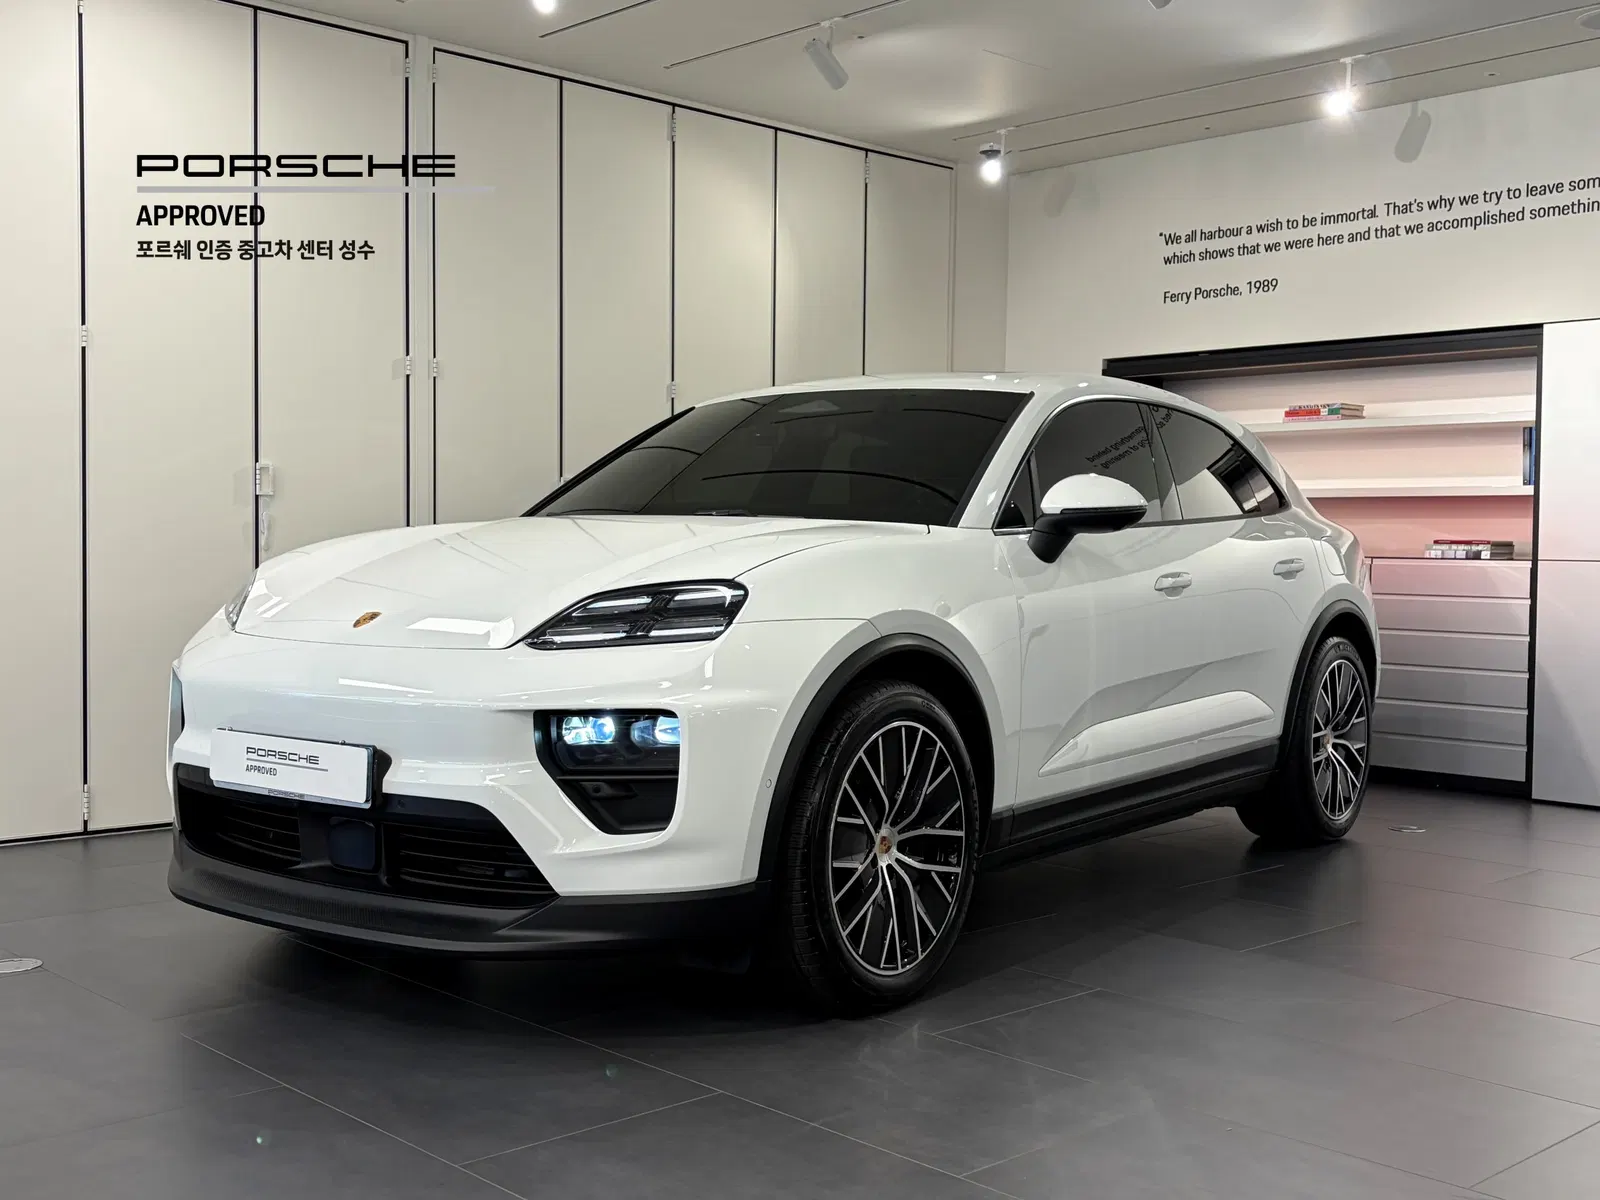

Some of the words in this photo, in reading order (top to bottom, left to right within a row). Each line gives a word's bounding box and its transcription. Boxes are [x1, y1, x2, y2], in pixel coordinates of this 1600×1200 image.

[1184, 229, 1197, 243] all
[1200, 226, 1243, 242] harbour
[1245, 225, 1253, 235] a
[1256, 218, 1283, 234] wish
[1286, 217, 1299, 230] to
[1302, 214, 1317, 228] be
[1320, 204, 1379, 226] immortal.
[1384, 198, 1424, 216] That's
[1427, 195, 1455, 212] why
[1458, 193, 1479, 206] we
[1483, 189, 1503, 206] try
[1506, 186, 1522, 200] to
[1525, 182, 1564, 198] leave
[1163, 250, 1196, 266] which
[1198, 245, 1235, 262] shows
[1237, 242, 1261, 257] that
[1264, 241, 1281, 253] we
[1284, 237, 1314, 251] were
[1317, 233, 1344, 247] here
[1347, 226, 1371, 243] and
[1374, 224, 1401, 239] that
[1404, 222, 1424, 235] we
[1427, 206, 1526, 232] accomplished
[1529, 197, 1600, 220] somethin
[1163, 290, 1192, 305] Ferry
[1194, 283, 1243, 300] Porsche,
[1246, 277, 1279, 294] 1989
[246, 746, 320, 765] PORSCHE
[245, 764, 278, 777] APPROVED
